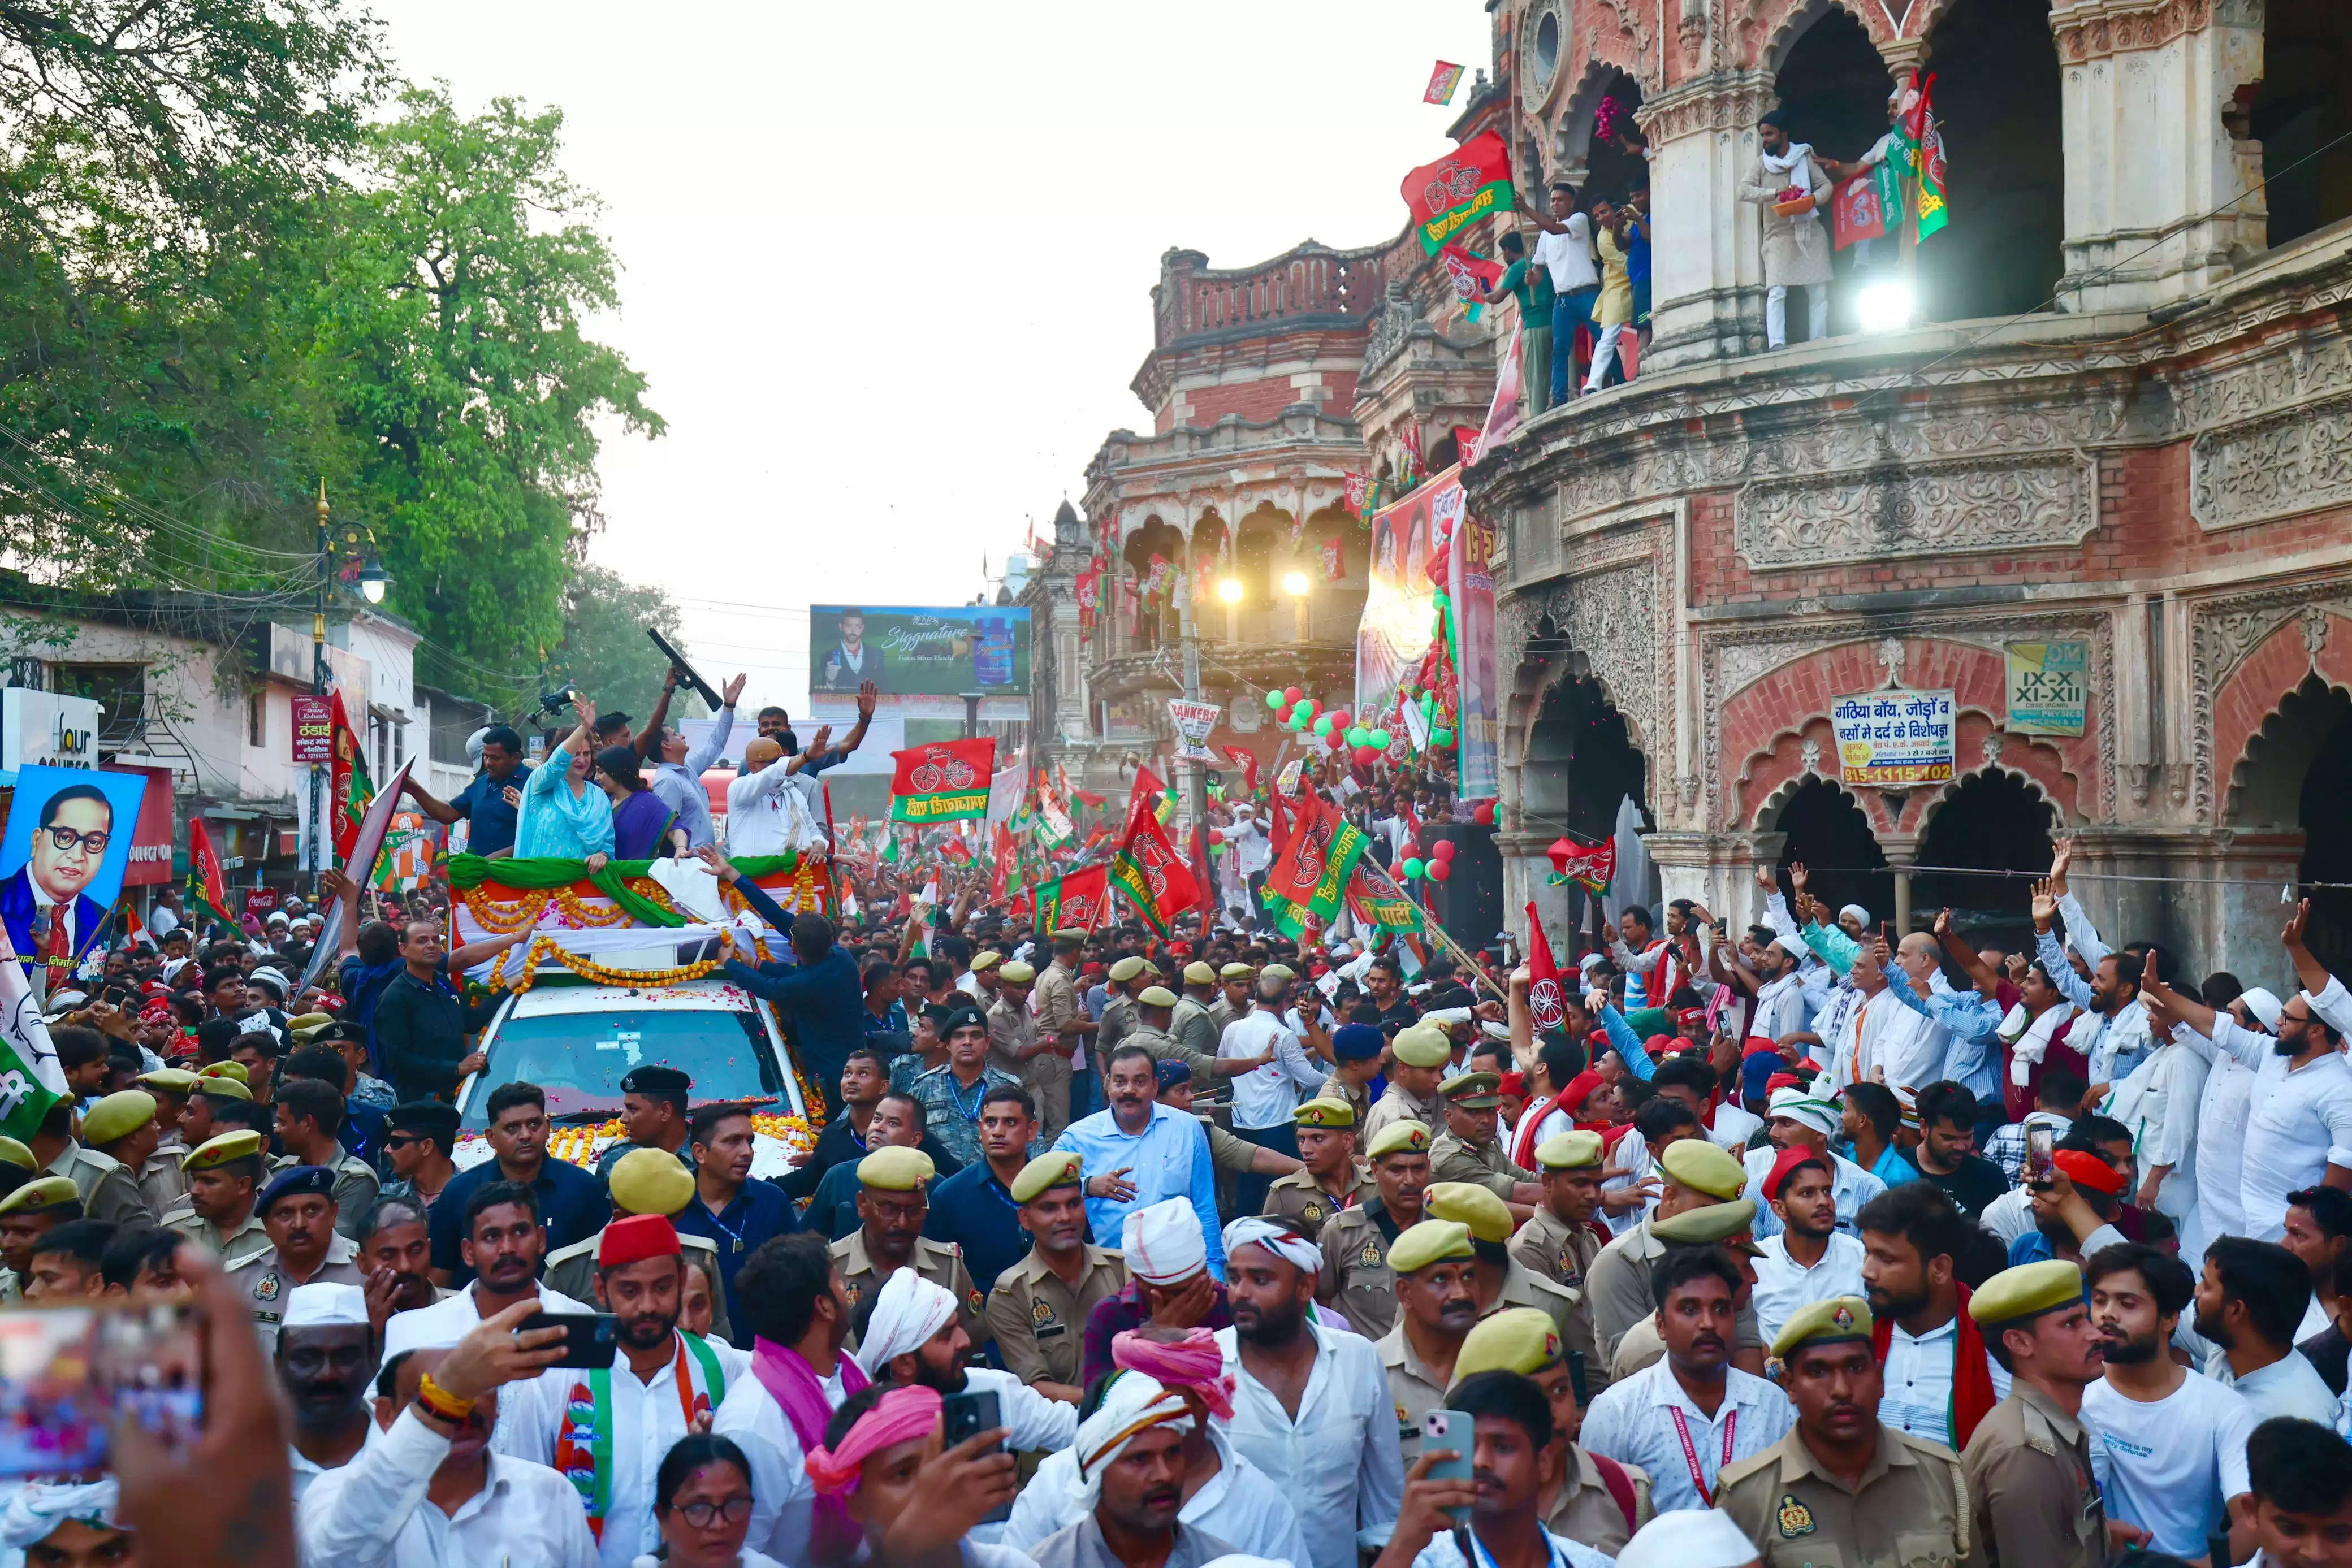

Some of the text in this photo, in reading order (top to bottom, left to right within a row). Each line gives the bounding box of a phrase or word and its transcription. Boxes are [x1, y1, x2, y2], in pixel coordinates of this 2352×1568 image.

[881, 623, 968, 651] Siggnature
[2024, 672, 2073, 686] IX-X
[2016, 687, 2079, 702] XI-XII
[1835, 700, 1870, 719] गठिया
[1939, 701, 1949, 714] व
[57, 711, 91, 754] four
[1839, 723, 1860, 740] नसों
[1874, 721, 1891, 739] दर्द
[1893, 721, 1906, 738] के
[1909, 720, 1949, 739] विशेषज्ञ
[1845, 765, 1951, 782] 915-1115-102
[1377, 901, 1414, 926] पार्टी
[2103, 1438, 2118, 1449] only
[2142, 1446, 2153, 1454] my
